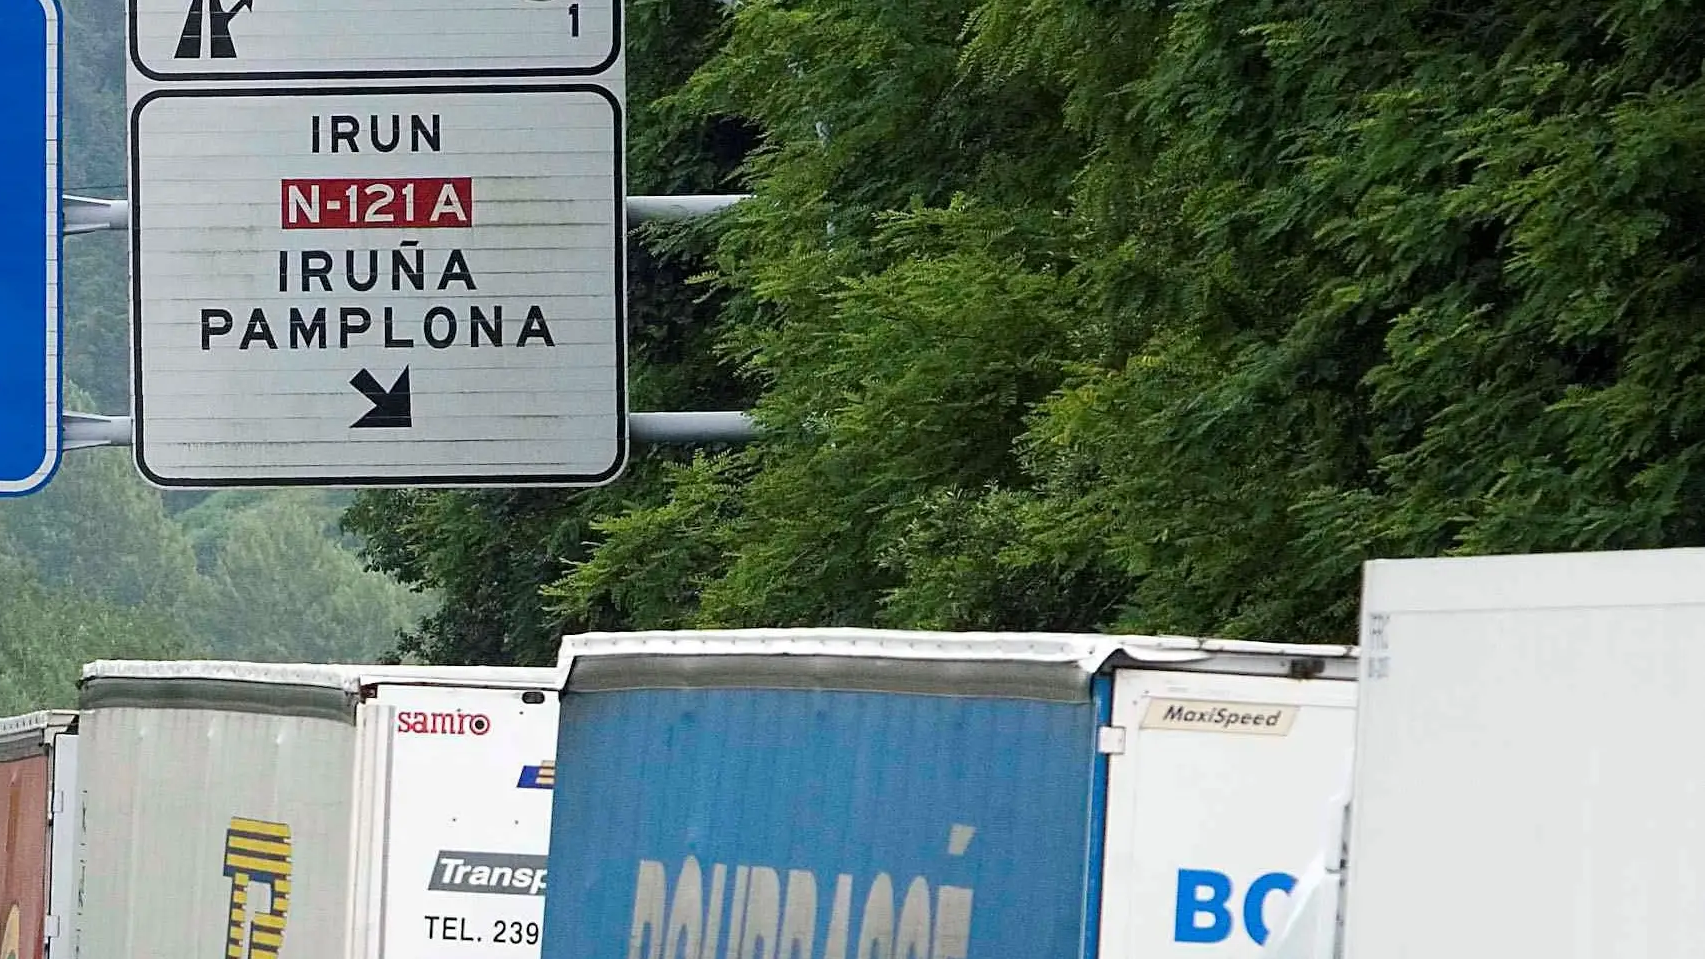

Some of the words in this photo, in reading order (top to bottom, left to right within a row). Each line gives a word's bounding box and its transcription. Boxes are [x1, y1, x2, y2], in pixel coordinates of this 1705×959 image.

[568, 3, 579, 37] 1
[311, 114, 441, 154] IRUN
[278, 240, 477, 293] IRUÑA
[200, 305, 556, 351] PAMPLONA
[398, 711, 491, 736] samro
[1162, 704, 1284, 729] MaxiSpeed
[424, 915, 482, 942] TEL.
[493, 919, 539, 945] 239
